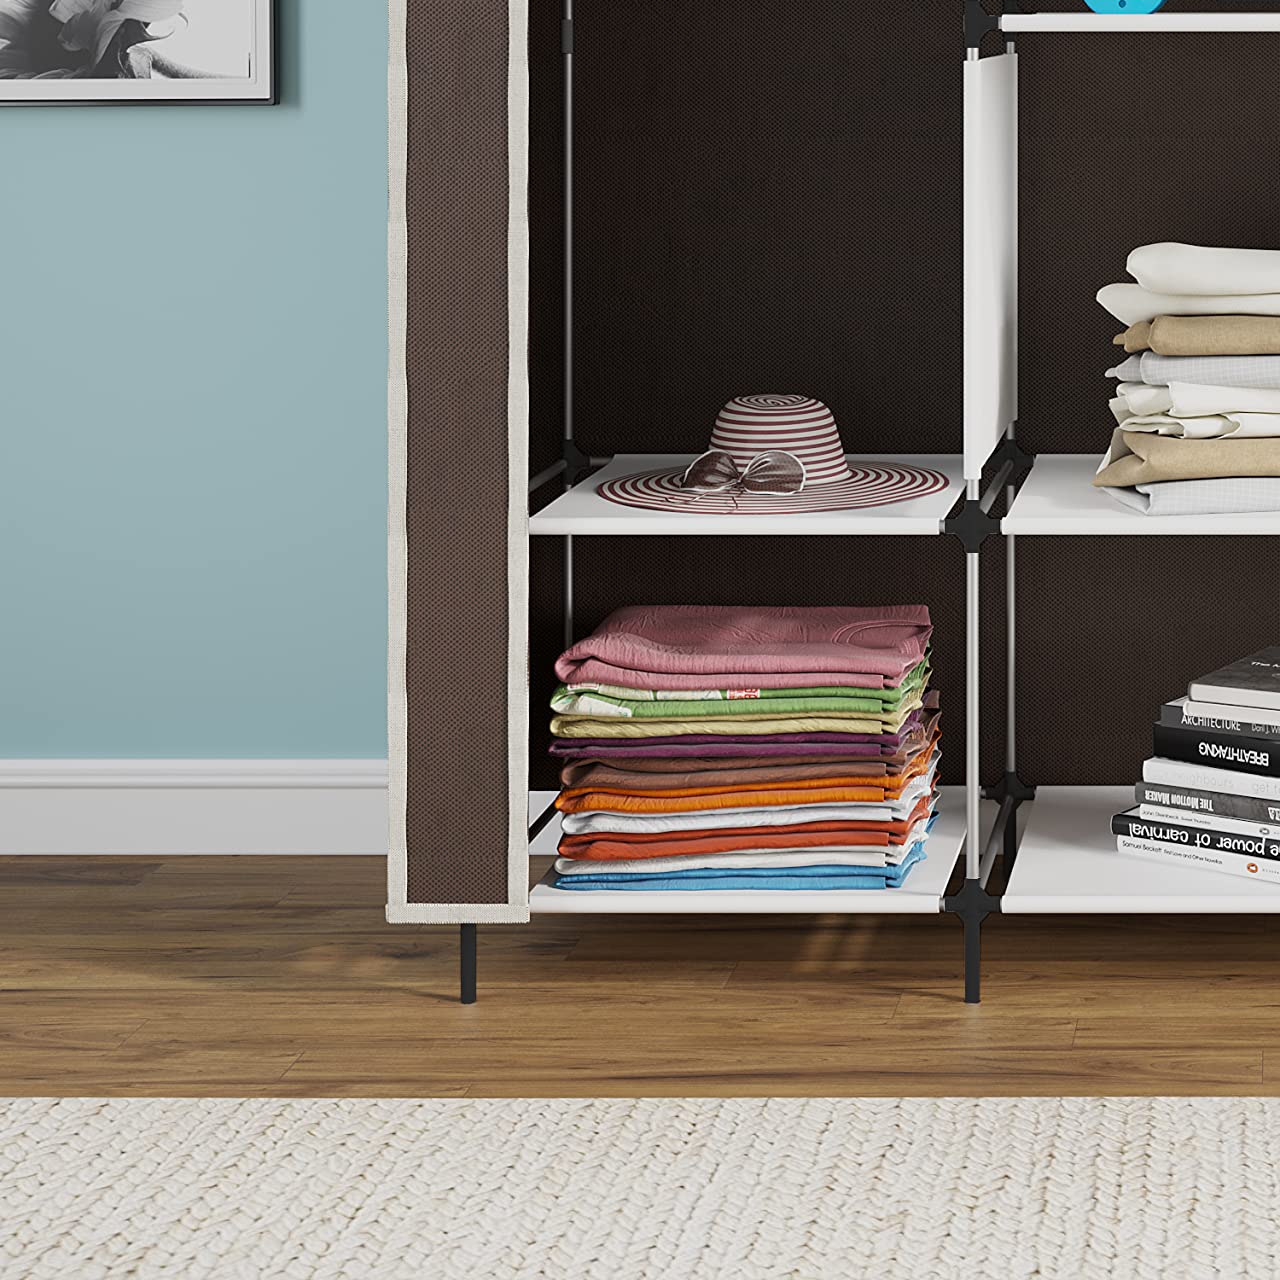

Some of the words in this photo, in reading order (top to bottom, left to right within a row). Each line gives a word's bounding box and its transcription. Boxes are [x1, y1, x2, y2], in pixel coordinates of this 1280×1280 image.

[1181, 714, 1241, 732] ARCHITECTURE
[1199, 741, 1269, 767] BREATHTAKING
[1145, 790, 1170, 805] MAKER
[1171, 793, 1199, 810] MOTION
[1200, 797, 1214, 812] THE
[1128, 823, 1189, 844] carnival
[1195, 832, 1211, 848] of
[1216, 837, 1266, 856] power
